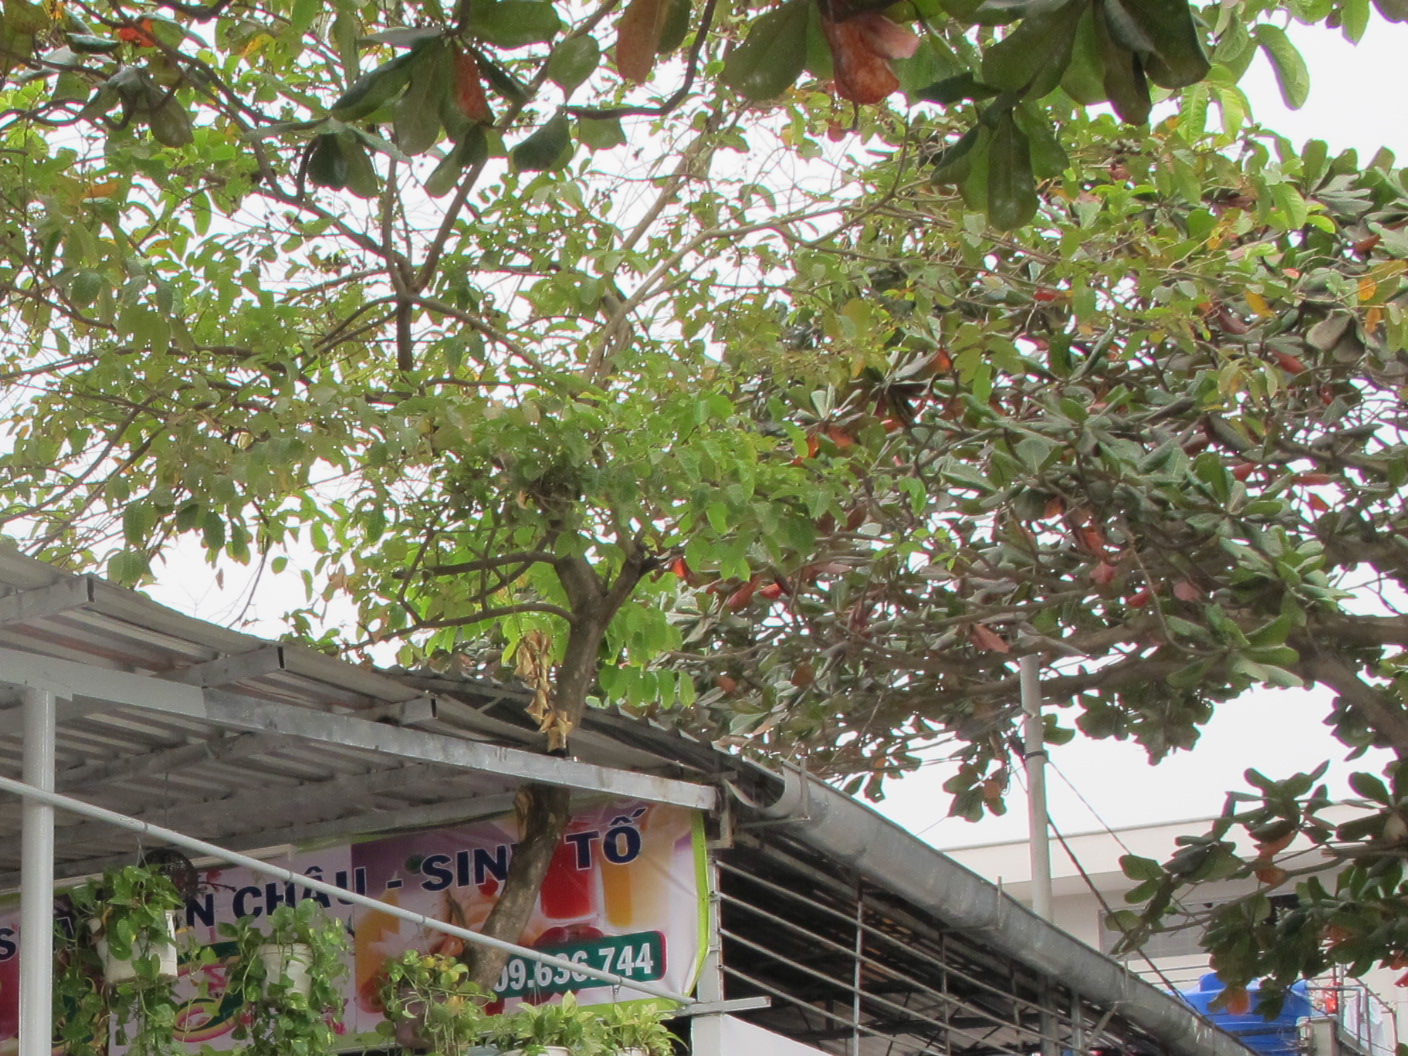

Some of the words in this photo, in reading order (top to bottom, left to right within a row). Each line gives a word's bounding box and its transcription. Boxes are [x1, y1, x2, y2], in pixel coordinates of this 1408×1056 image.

[231, 865, 368, 919] CHÂU
[420, 844, 518, 893] SIN
[565, 807, 648, 871] TỐ
